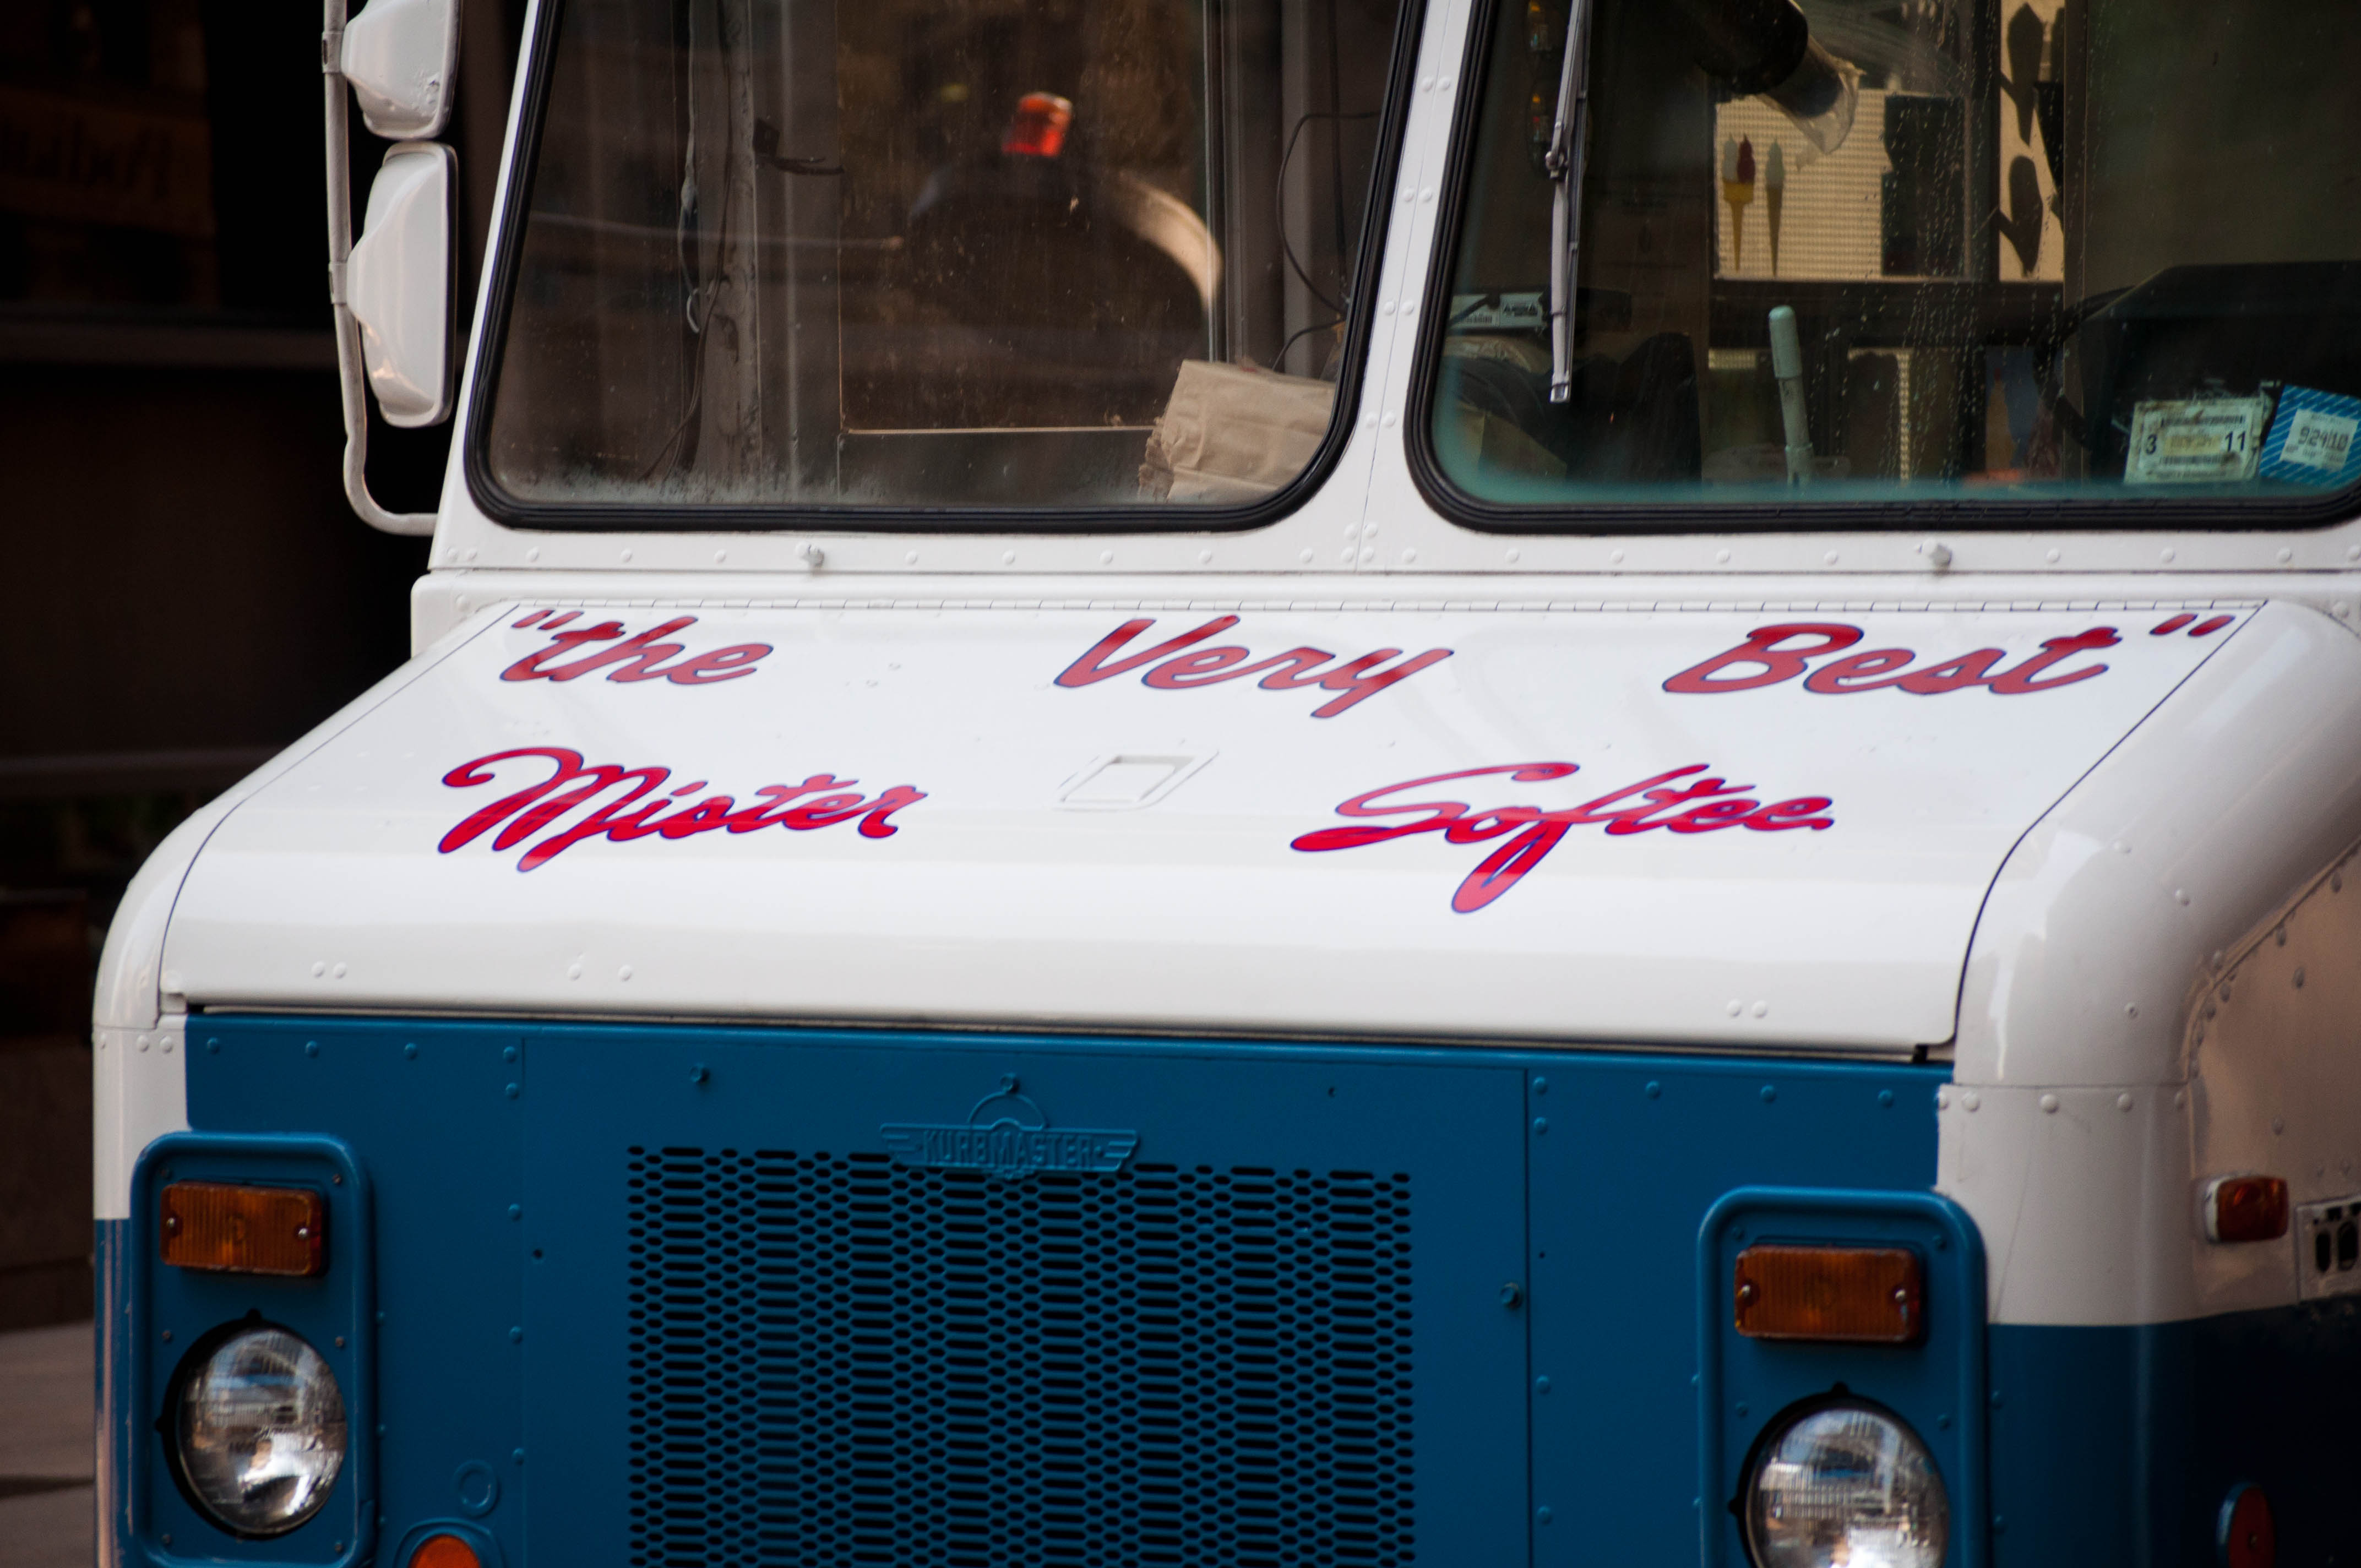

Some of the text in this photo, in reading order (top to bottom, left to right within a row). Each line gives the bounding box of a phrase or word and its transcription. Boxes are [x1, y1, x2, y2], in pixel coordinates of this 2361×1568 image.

[2146, 433, 2157, 455] 3
[2225, 431, 2246, 452] 11
[1053, 614, 1454, 718] Very
[438, 746, 1835, 913] Mister Softee
[922, 1129, 1096, 1167] KURBMASTER
